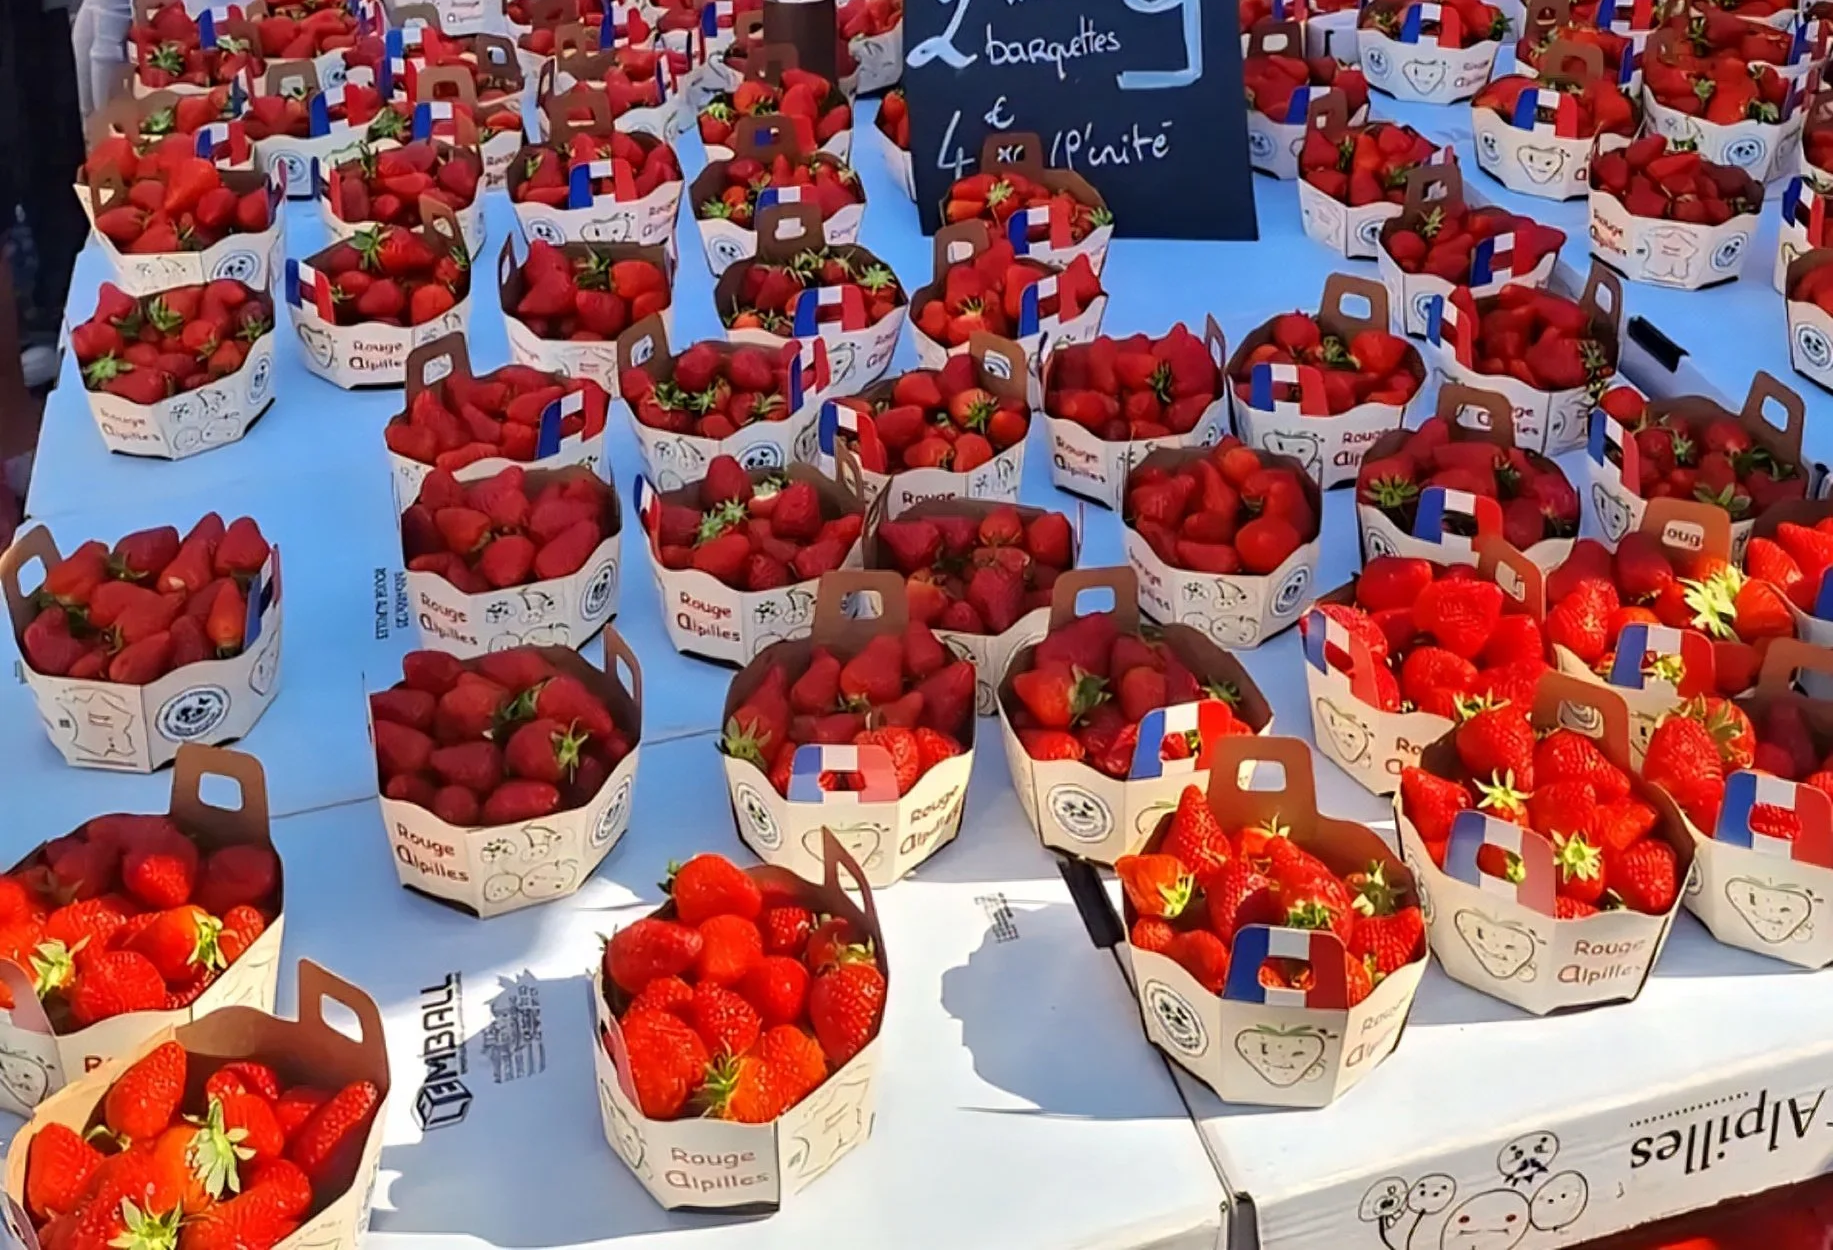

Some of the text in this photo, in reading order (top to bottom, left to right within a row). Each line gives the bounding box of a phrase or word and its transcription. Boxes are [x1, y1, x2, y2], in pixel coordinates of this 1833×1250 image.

[985, 14, 1121, 80] barquettes
[936, 110, 976, 181] 4
[680, 591, 732, 620] Rouge
[396, 822, 456, 858] Rouge
[1630, 1088, 1827, 1176] Alpilles
[670, 1147, 757, 1170] Rouge
